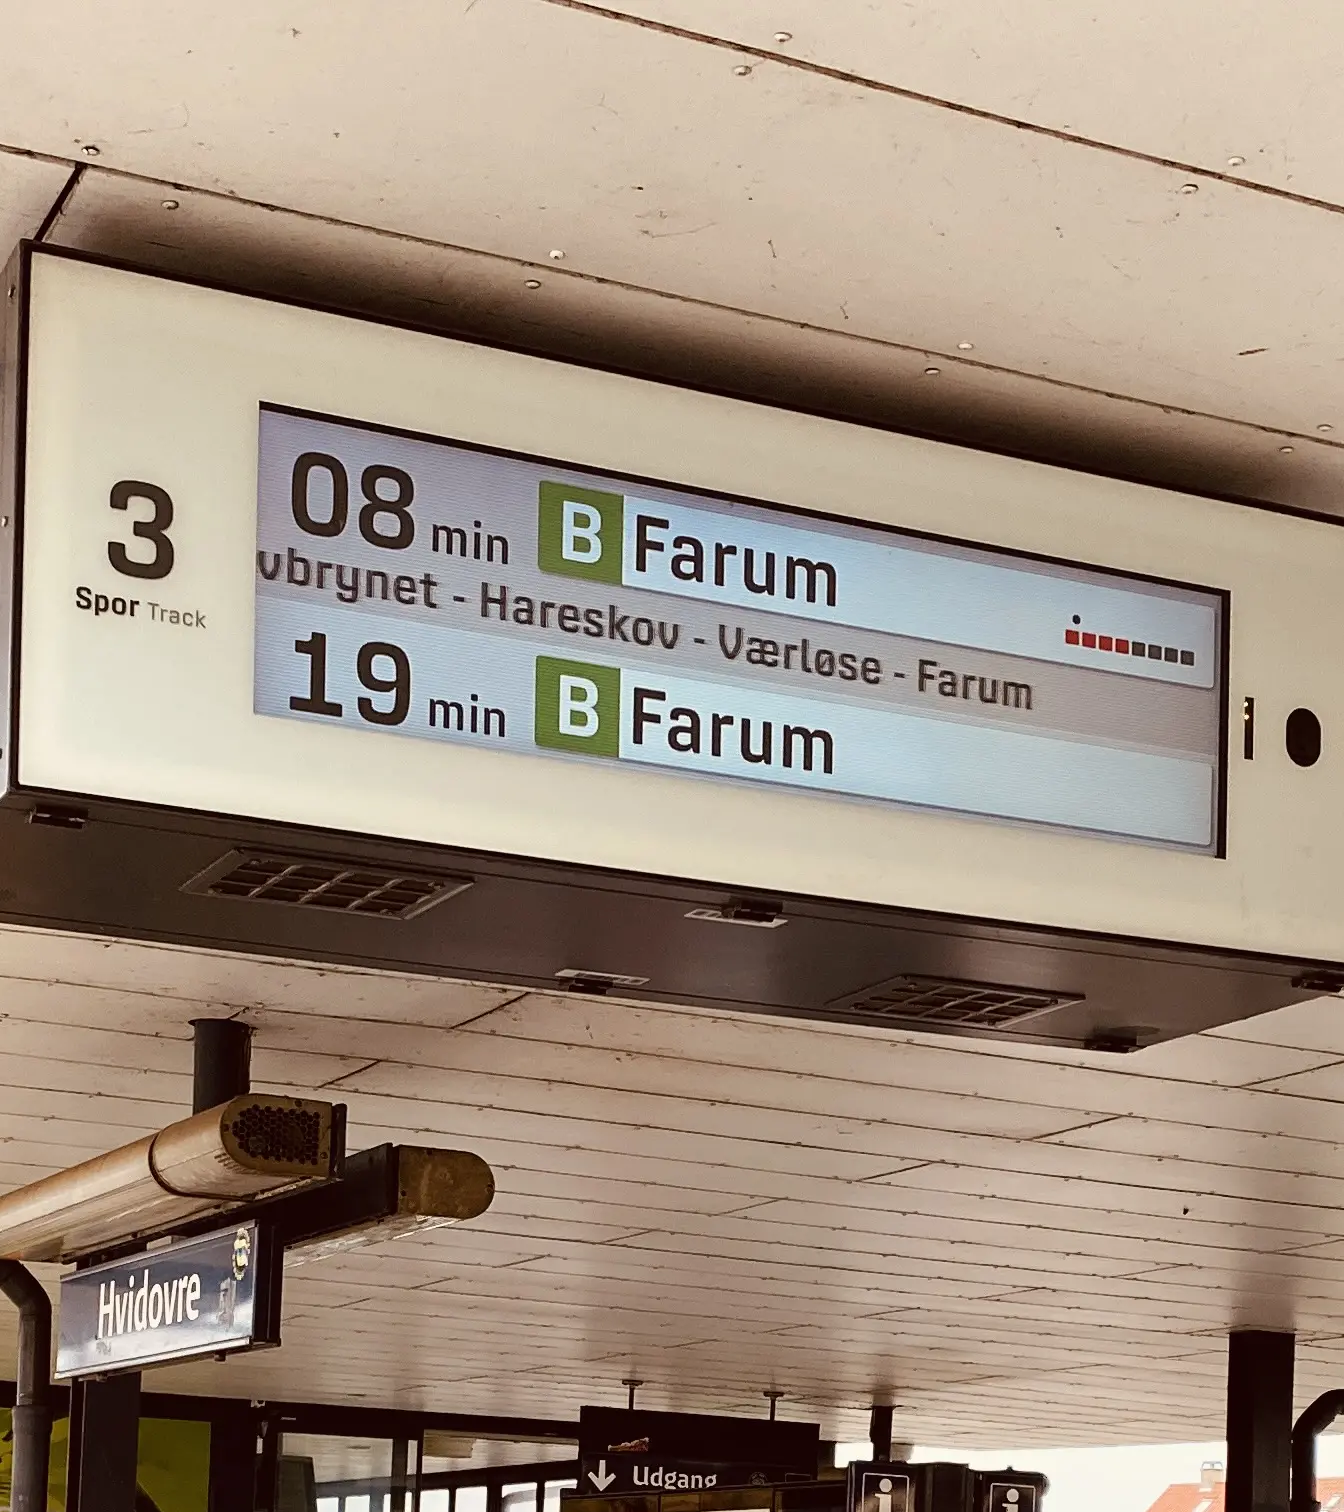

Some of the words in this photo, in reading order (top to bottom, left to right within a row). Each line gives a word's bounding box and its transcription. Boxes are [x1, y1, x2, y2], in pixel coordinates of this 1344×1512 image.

[107, 480, 175, 580] 3
[290, 451, 416, 550] 08
[431, 520, 511, 565] min
[560, 502, 603, 565] B
[634, 515, 838, 607] Farum
[75, 586, 140, 622] Spor
[147, 601, 207, 630] Track
[480, 581, 679, 650] Hareskov
[719, 625, 882, 685] Værløse
[916, 659, 1034, 711] Farum
[289, 631, 412, 726] 19
[429, 694, 506, 738] min
[559, 674, 600, 738] B
[632, 686, 835, 775] Farum
[97, 1268, 201, 1338] Hvidovre
